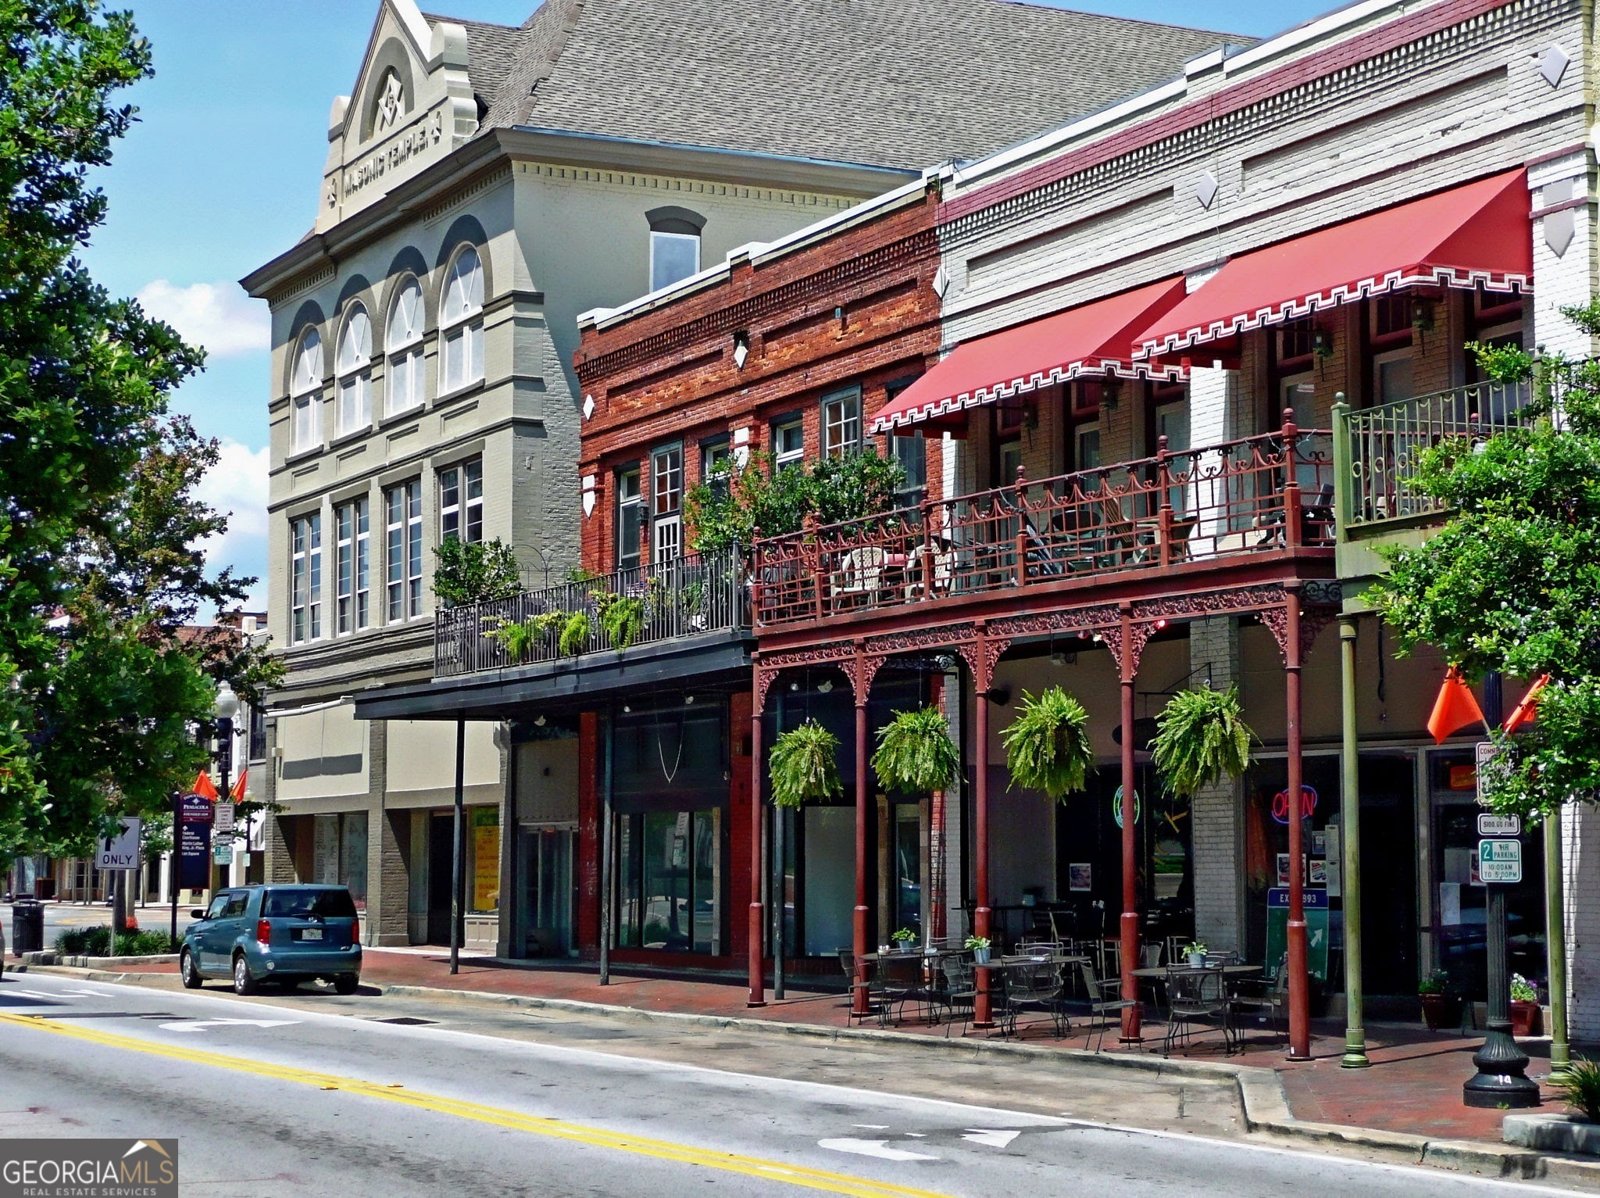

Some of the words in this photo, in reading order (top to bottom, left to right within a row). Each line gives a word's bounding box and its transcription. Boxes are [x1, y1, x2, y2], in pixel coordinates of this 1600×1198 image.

[344, 152, 385, 198] MASONIC
[385, 126, 429, 171] TEMPLE
[1273, 792, 1315, 817] OPN
[103, 854, 133, 865] ONLY
[1483, 843, 1491, 859] 2
